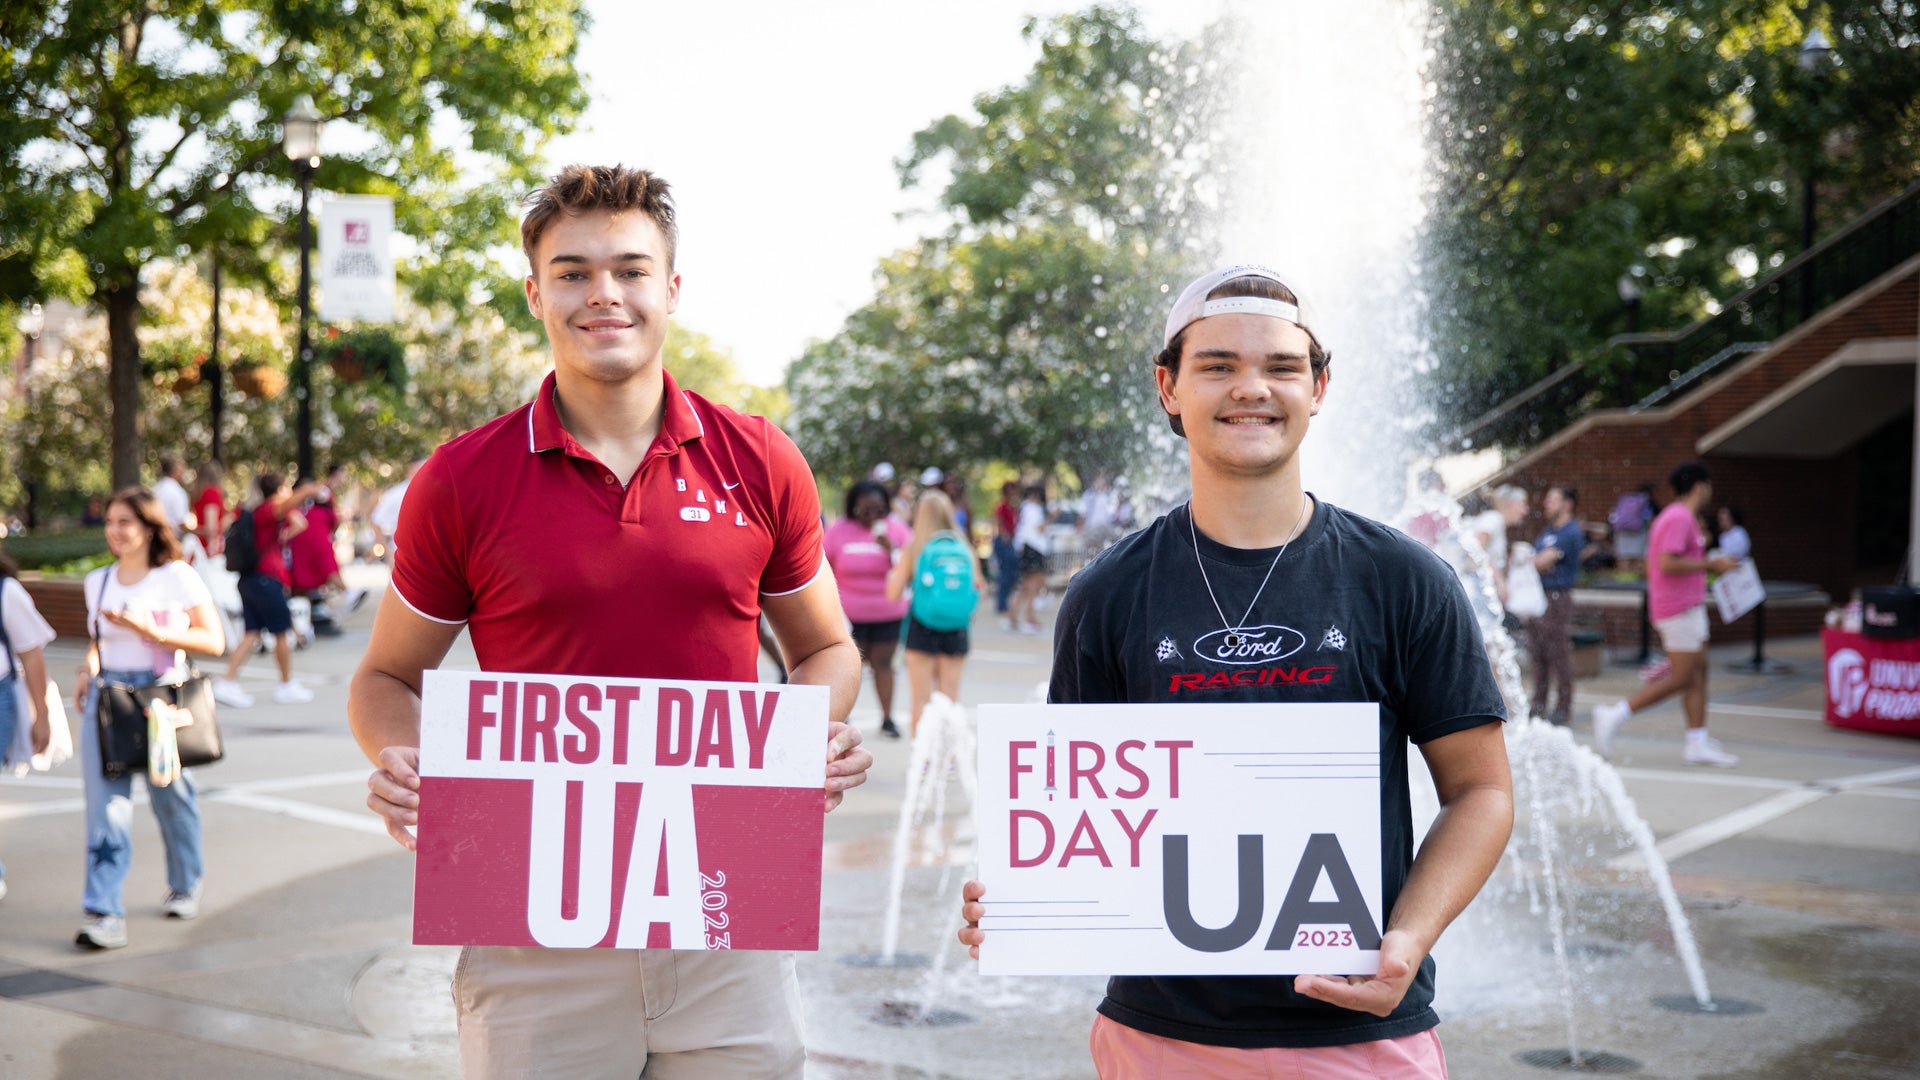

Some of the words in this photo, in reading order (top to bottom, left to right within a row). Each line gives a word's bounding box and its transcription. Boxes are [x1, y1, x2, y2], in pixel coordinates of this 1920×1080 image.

[1168, 666, 1337, 693] RACING
[1217, 631, 1283, 657] Ford
[466, 679, 641, 765] FIRST
[655, 686, 780, 770] DAY
[1008, 728, 1194, 802] FIRST
[526, 775, 706, 951] UA
[1009, 808, 1159, 869] DAY
[699, 869, 731, 951] 2023
[1162, 832, 1383, 954] UA
[1296, 929, 1353, 948] 2023
